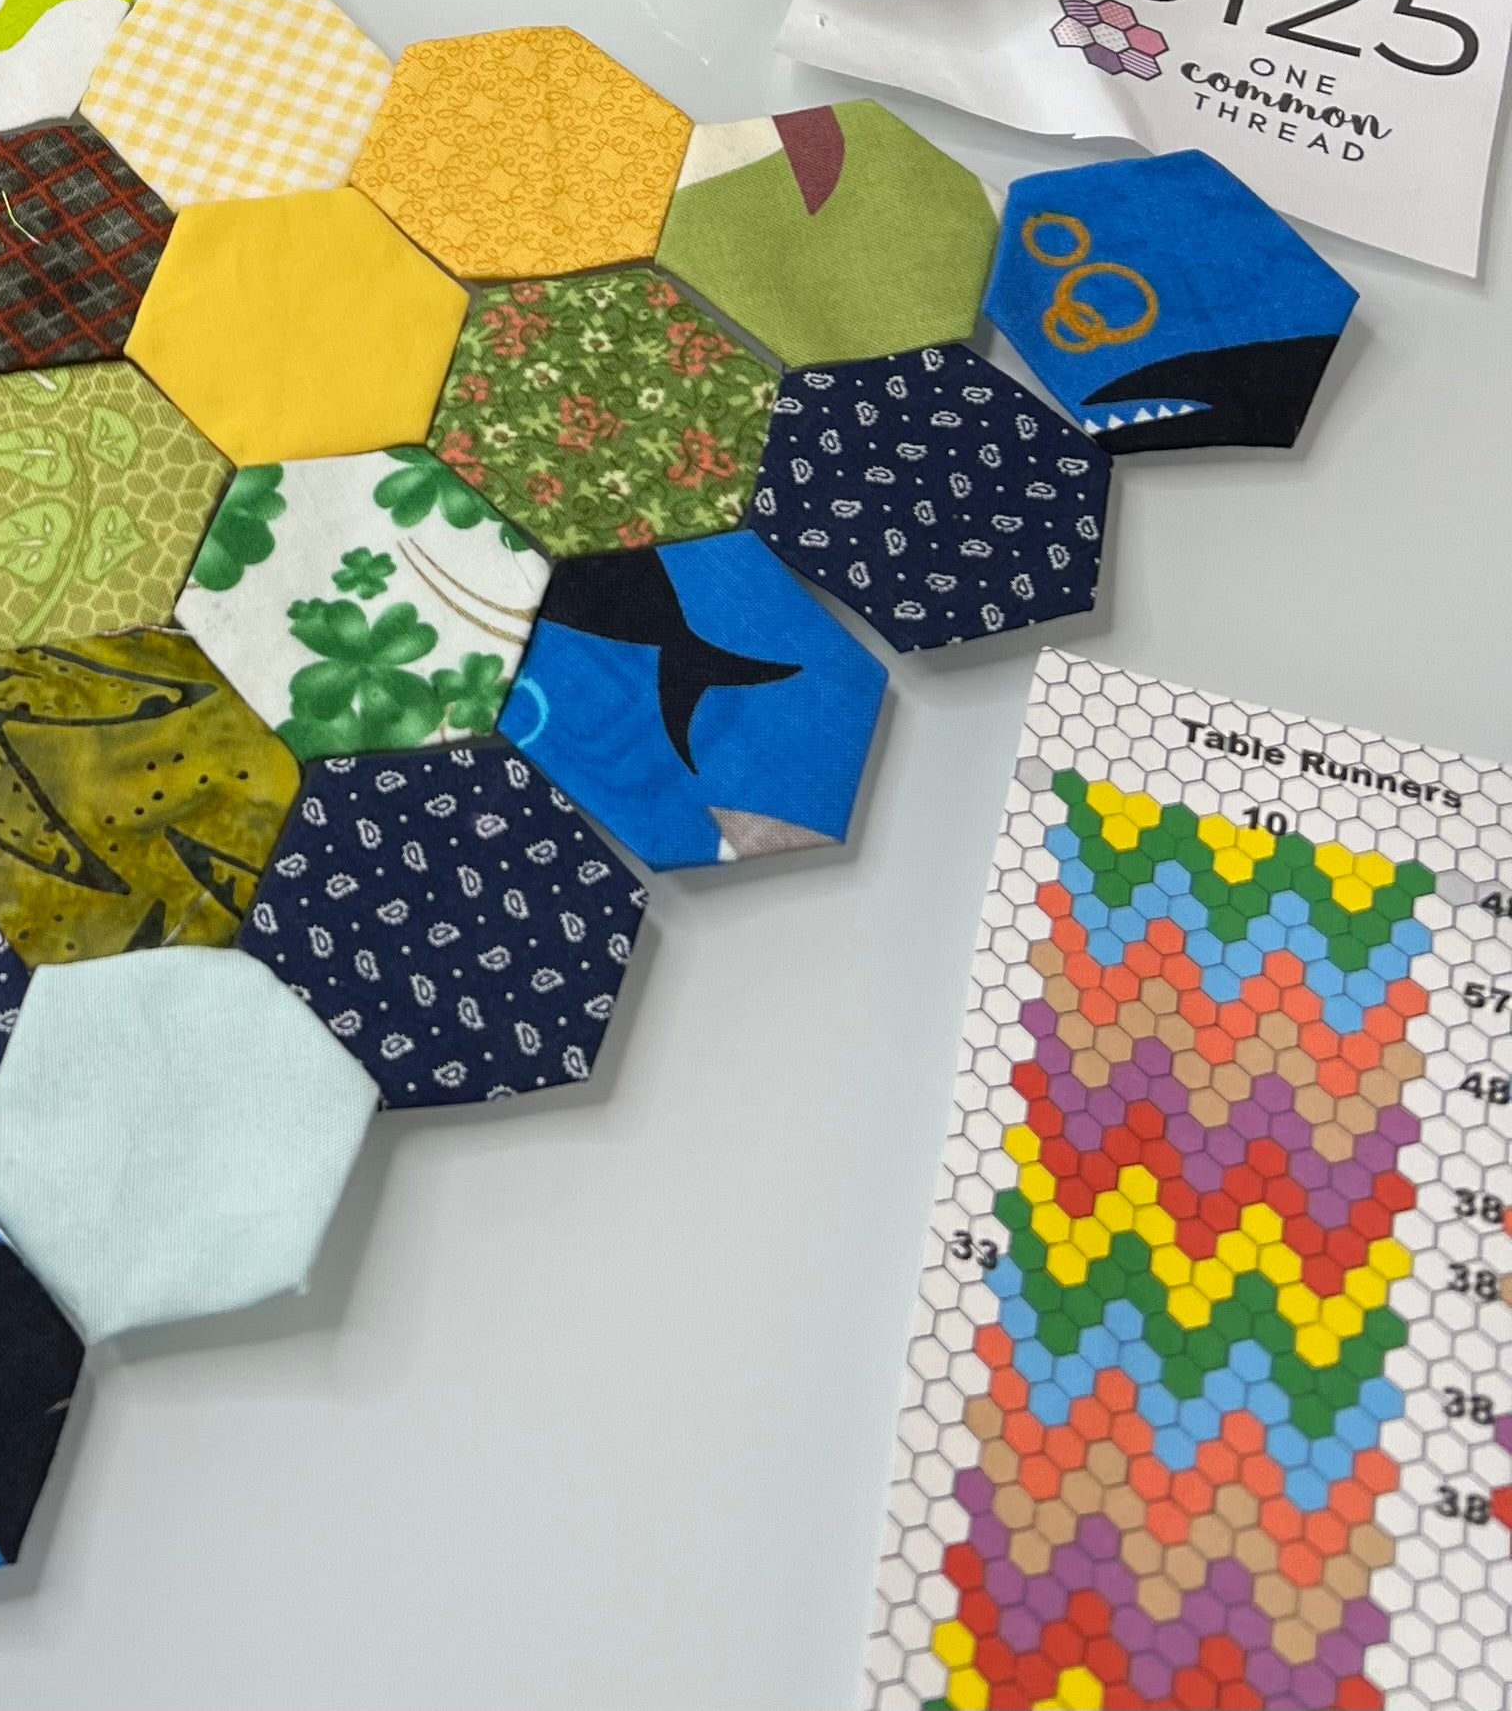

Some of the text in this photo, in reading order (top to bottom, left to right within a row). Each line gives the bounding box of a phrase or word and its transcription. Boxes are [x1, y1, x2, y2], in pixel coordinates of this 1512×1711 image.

[1249, 57, 1338, 96] ONE
[1179, 61, 1393, 140] common
[1192, 92, 1366, 162] THREAD
[1180, 717, 1463, 810] Table Runners
[1242, 806, 1288, 837] 10
[1480, 891, 1512, 919] 4
[1463, 981, 1512, 1013] 57
[1458, 1072, 1510, 1105] 48
[1454, 1188, 1504, 1224] 38
[950, 1229, 999, 1271] 33
[1448, 1263, 1498, 1301] 38
[1442, 1386, 1495, 1425] 38
[1434, 1486, 1490, 1525] 38
